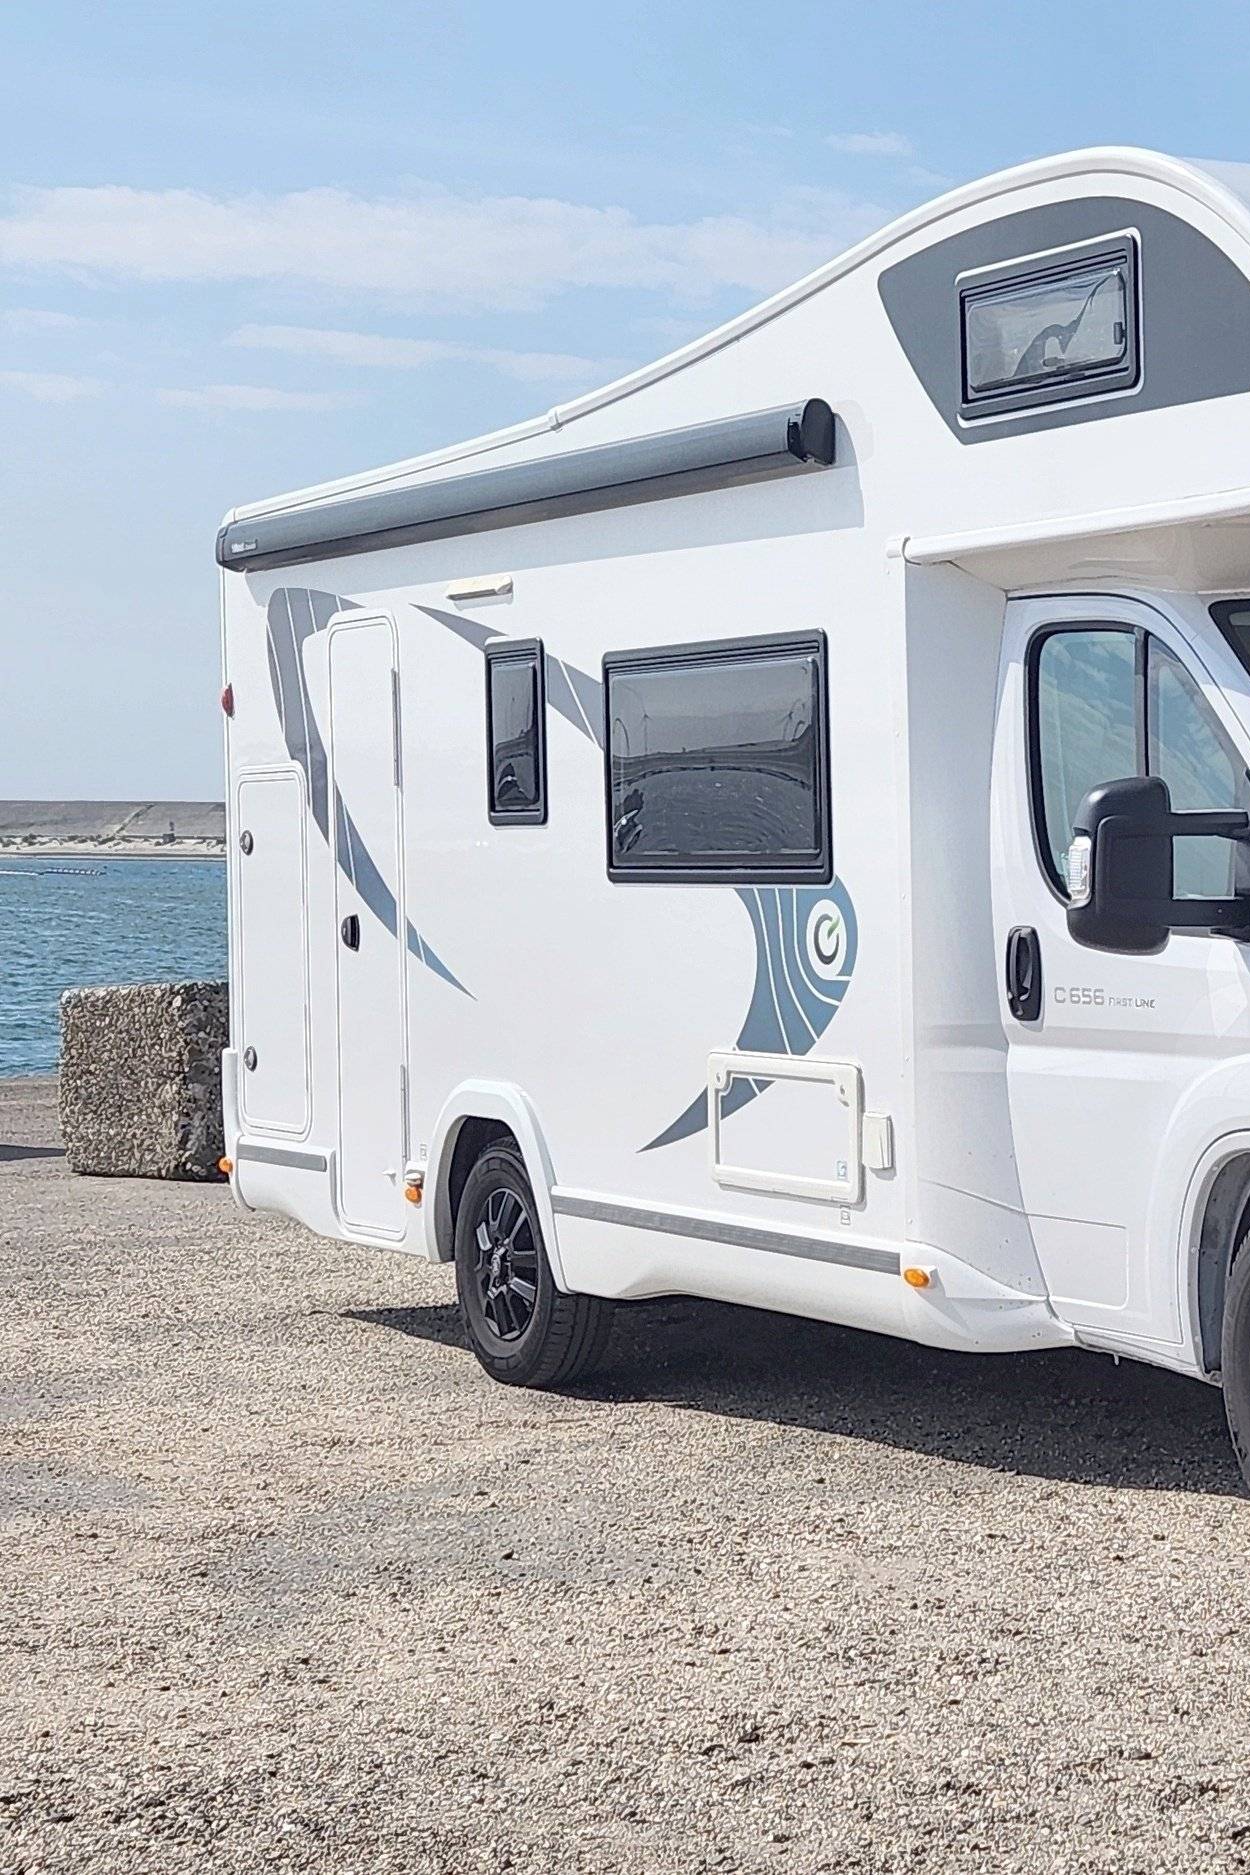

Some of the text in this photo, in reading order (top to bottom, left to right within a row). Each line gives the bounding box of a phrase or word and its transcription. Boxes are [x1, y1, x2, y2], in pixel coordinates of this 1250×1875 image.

[1054, 986, 1156, 1009] C 656 FIRST LINE
